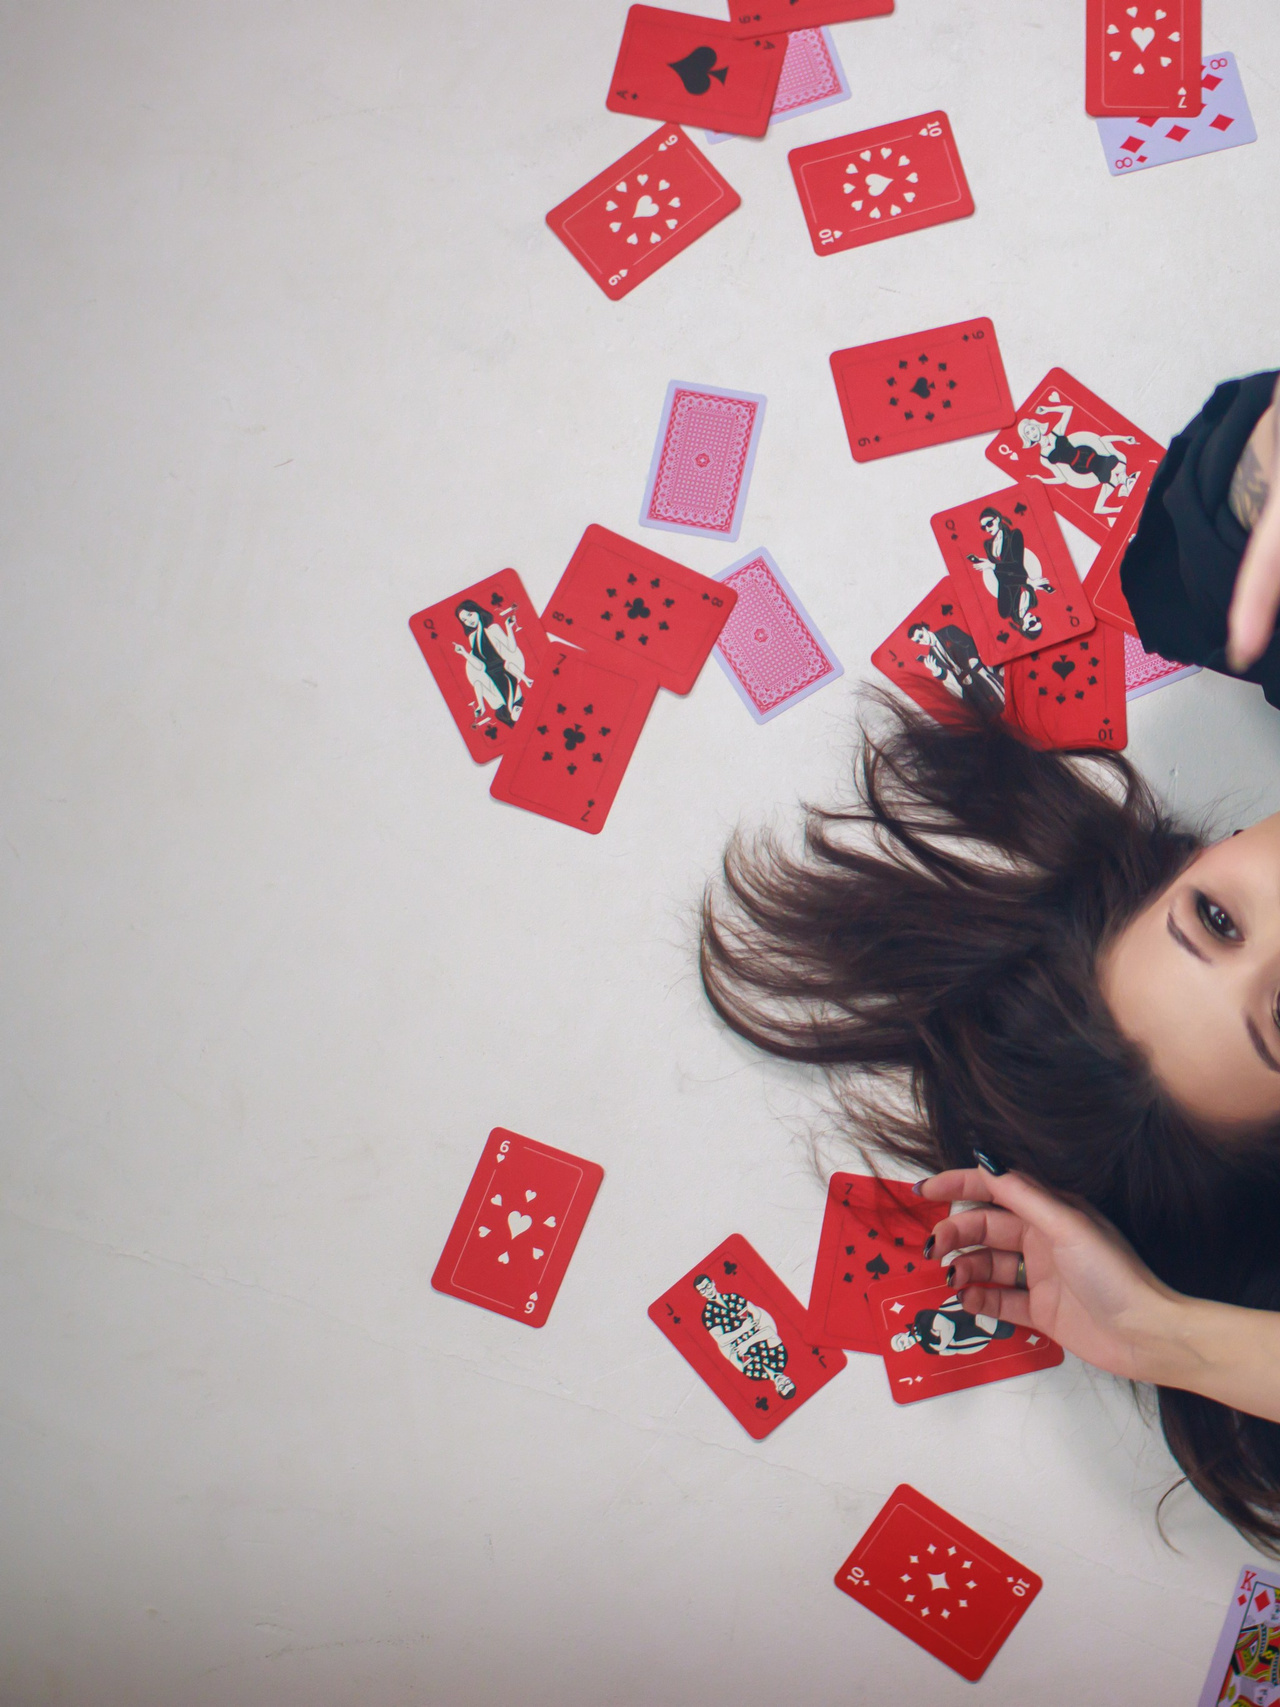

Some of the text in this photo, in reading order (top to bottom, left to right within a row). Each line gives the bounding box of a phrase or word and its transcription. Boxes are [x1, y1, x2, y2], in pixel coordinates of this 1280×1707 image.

[763, 41, 776, 50] A
[1210, 57, 1228, 70] 8
[616, 90, 628, 100] A
[1178, 96, 1187, 108] 7
[926, 121, 942, 138] 10
[664, 134, 678, 146] 9
[1115, 157, 1133, 169] 8
[819, 228, 835, 245] 10
[608, 274, 621, 286] 9
[971, 330, 985, 340] 9
[858, 437, 871, 447] 9
[998, 444, 1012, 455] Q
[945, 519, 957, 531] Q
[711, 597, 724, 608] 8
[552, 611, 565, 622] 8
[1069, 615, 1080, 628] Q
[423, 619, 435, 630] Q
[557, 653, 567, 665] 7
[889, 649, 897, 661] J
[1098, 729, 1113, 741] 10
[581, 811, 590, 822] 7
[500, 1140, 511, 1153] 6
[845, 1183, 853, 1195] 7
[524, 1301, 535, 1314] 6
[666, 1303, 674, 1316] J
[818, 1355, 827, 1369] J
[898, 1377, 913, 1385] J
[847, 1567, 864, 1586] 10
[1240, 1570, 1256, 1592] K
[1012, 1578, 1030, 1597] 10
